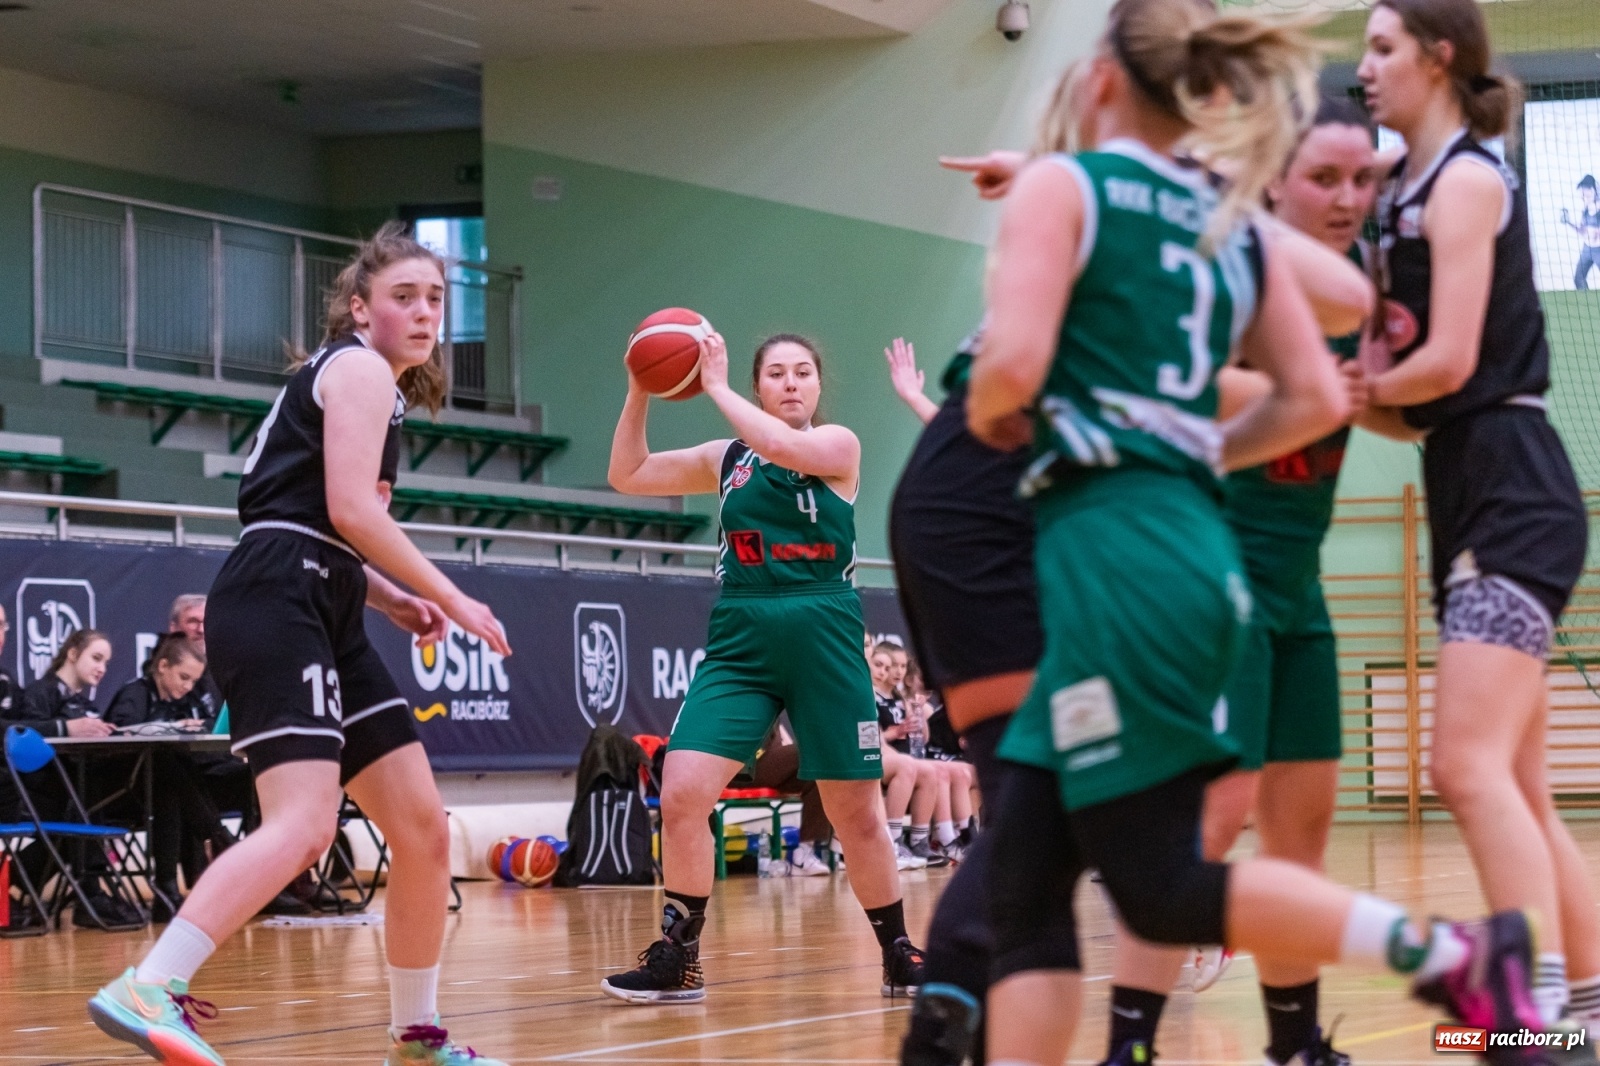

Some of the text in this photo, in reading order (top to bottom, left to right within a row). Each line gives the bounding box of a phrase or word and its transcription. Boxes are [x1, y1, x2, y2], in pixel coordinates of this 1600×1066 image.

[1158, 242, 1215, 400] 3
[796, 488, 819, 524] 4
[411, 619, 510, 692] OSiR
[302, 663, 343, 723] 13
[451, 694, 510, 720] RACIBÓRZ
